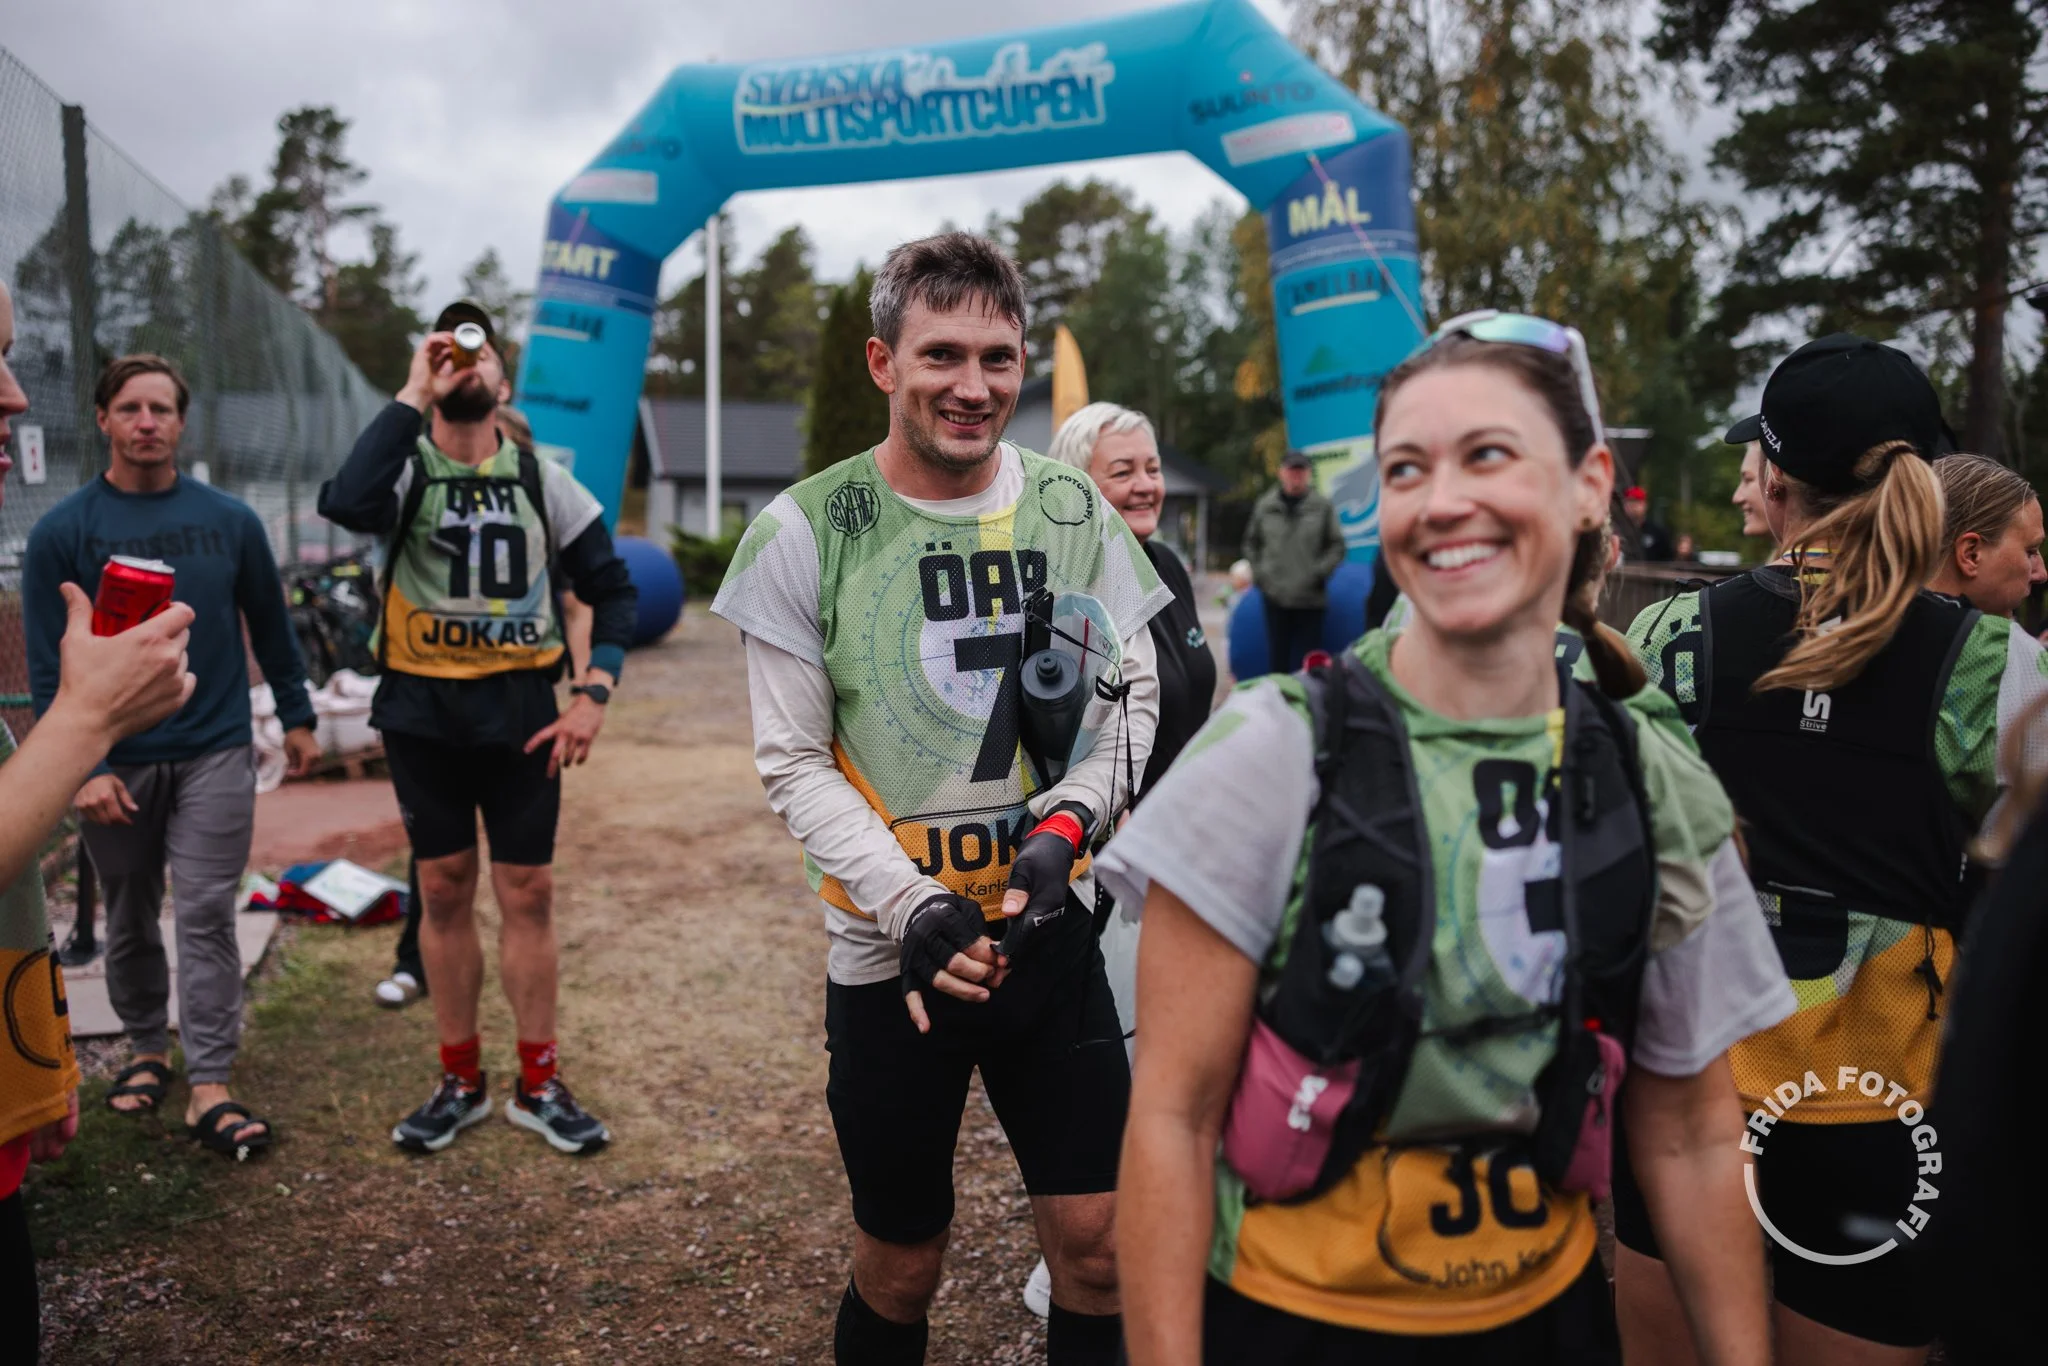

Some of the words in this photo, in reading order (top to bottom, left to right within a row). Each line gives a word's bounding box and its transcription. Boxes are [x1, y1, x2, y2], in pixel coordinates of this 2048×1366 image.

[744, 60, 906, 105] SVENSKA
[743, 76, 1099, 148] MULTISPORTCUPEN
[1288, 181, 1372, 236] MÅL
[436, 522, 529, 599] 10
[422, 618, 540, 648] JOKAB
[953, 632, 1024, 783] 7
[1800, 719, 1828, 731] Strive
